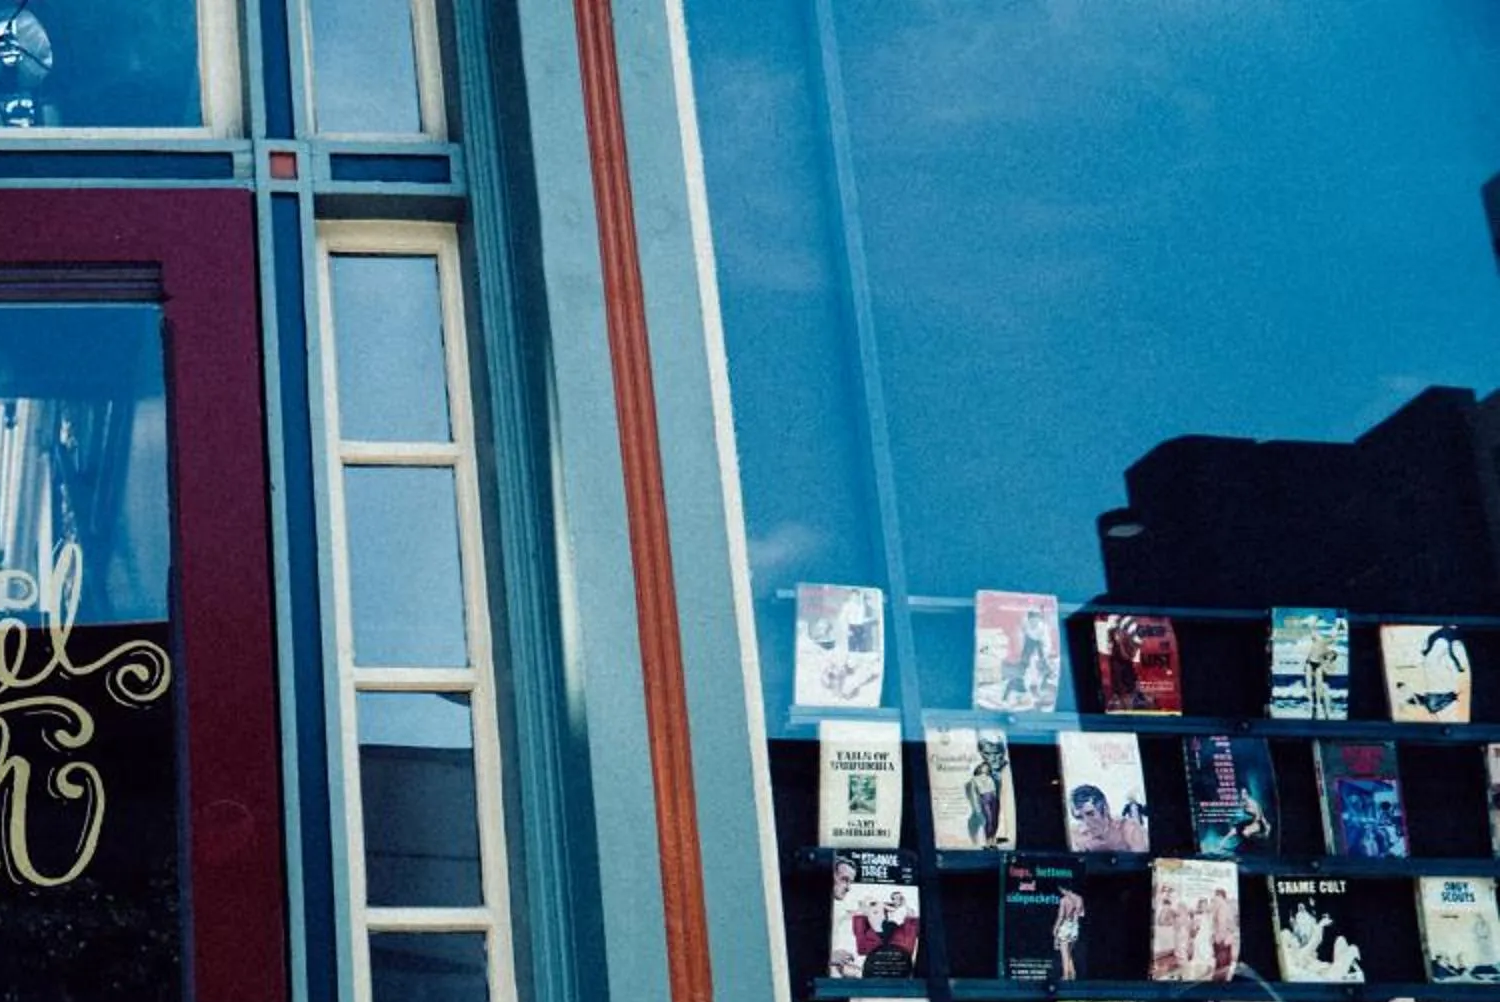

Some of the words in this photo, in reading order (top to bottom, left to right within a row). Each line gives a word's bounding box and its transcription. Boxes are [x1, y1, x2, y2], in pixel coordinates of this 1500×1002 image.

[861, 852, 900, 867] STRANGE
[861, 865, 889, 879] THREE
[1019, 880, 1037, 891] and
[1277, 881, 1316, 895] SHAME
[1319, 880, 1347, 894] CULT
[1441, 891, 1475, 903] SCOUTS
